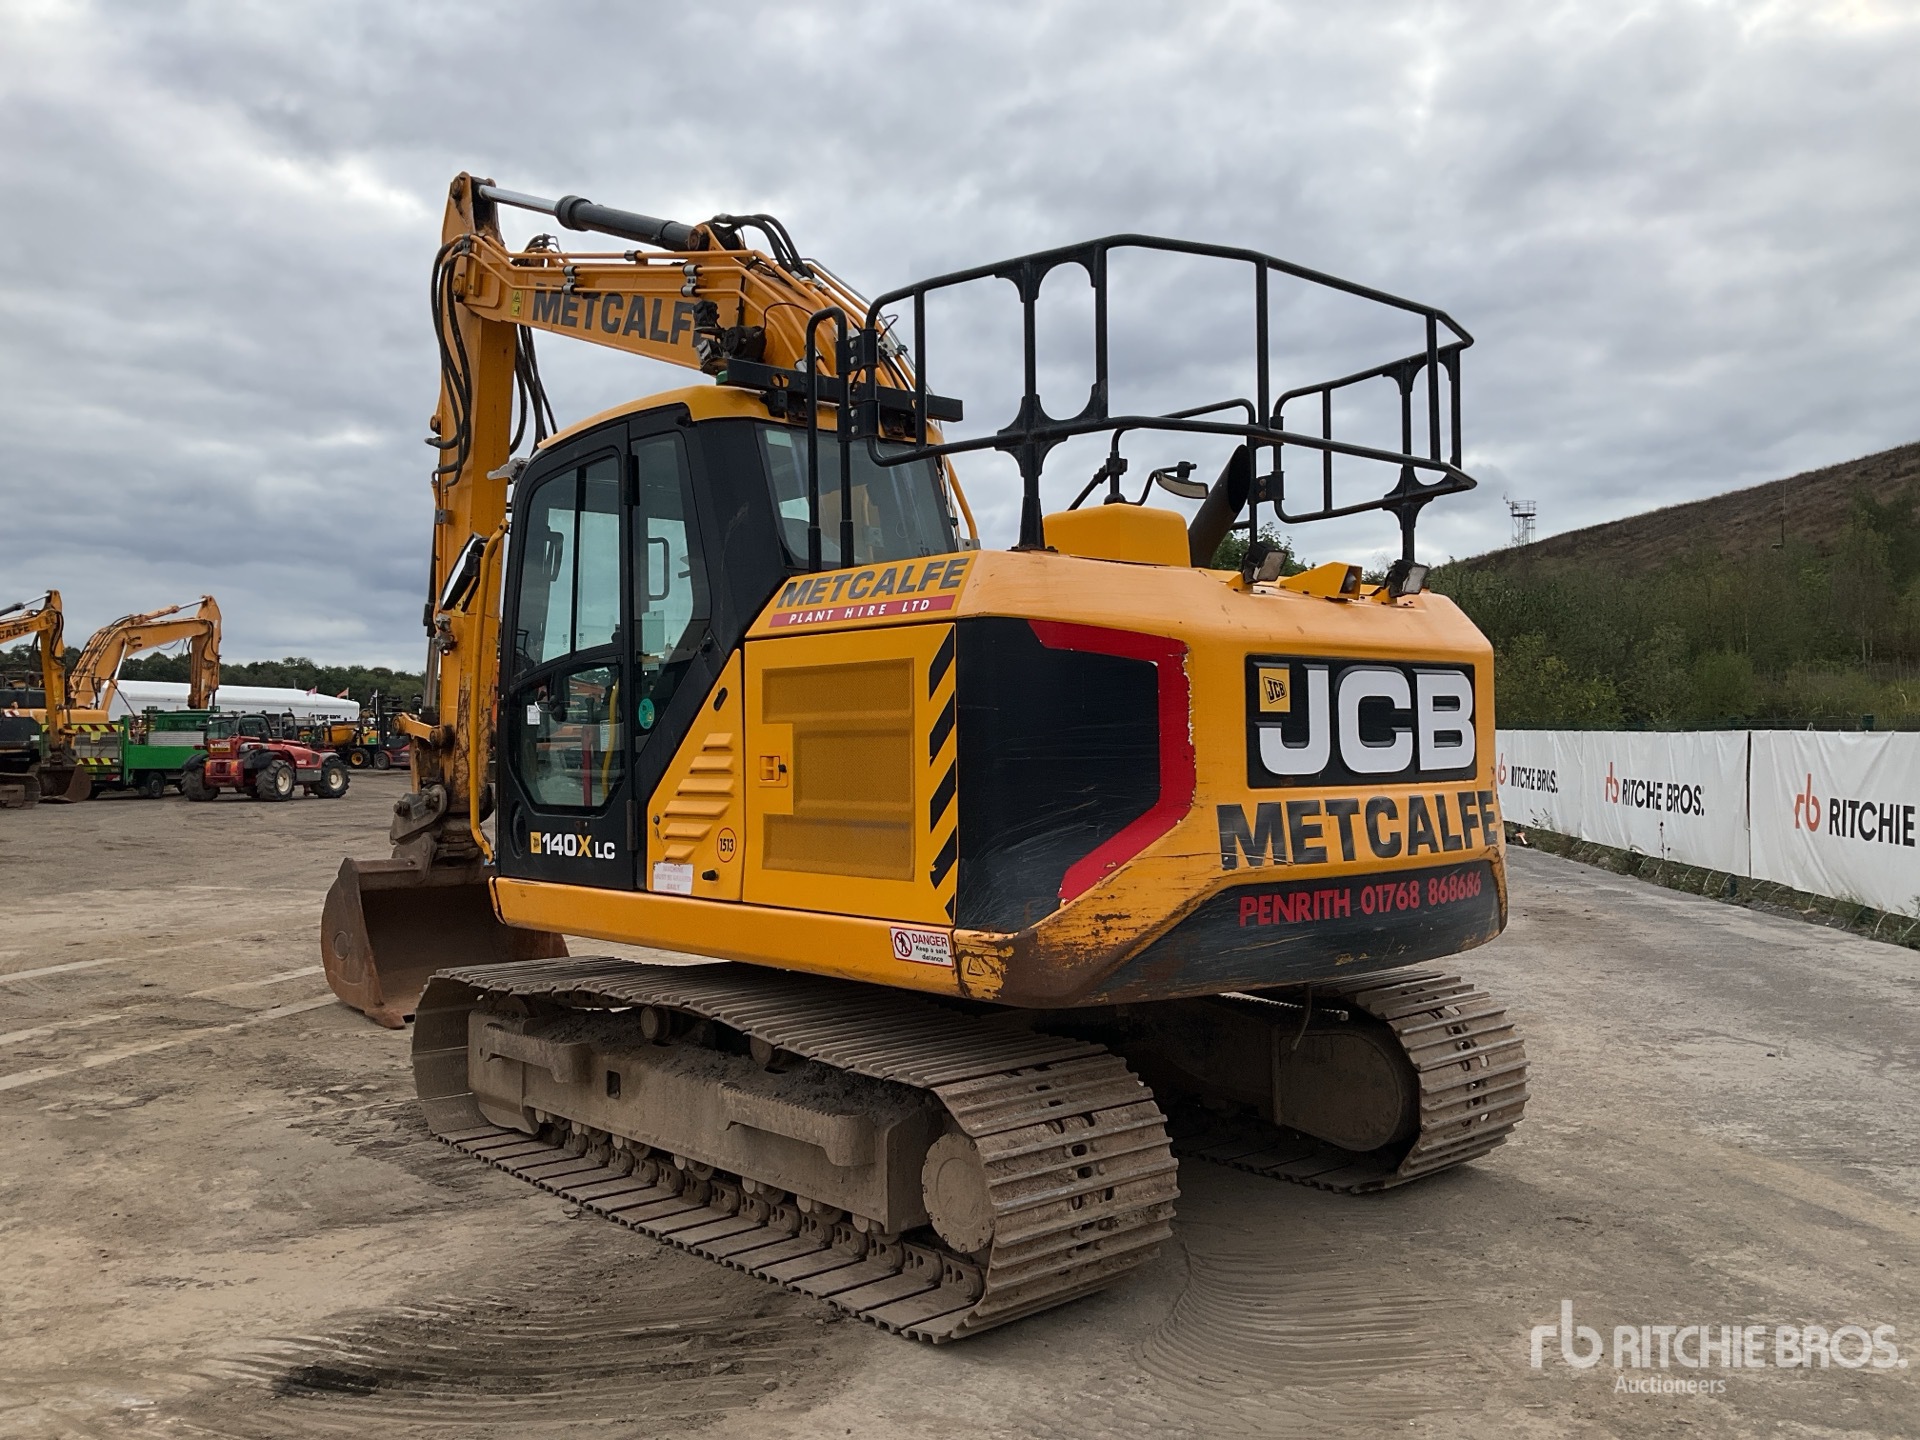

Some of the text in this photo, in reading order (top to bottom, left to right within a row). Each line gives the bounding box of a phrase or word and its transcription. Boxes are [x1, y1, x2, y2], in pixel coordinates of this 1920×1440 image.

[776, 557, 970, 609] METCALFE
[788, 599, 931, 625] PLANT HIRE LTD
[1266, 678, 1287, 700] JCB
[1258, 665, 1476, 776] JCB
[1511, 765, 1535, 791] ITCHE
[1622, 778, 1663, 811] RITCHE
[1666, 783, 1705, 816] BROS.
[1216, 790, 1499, 870] METCALFE
[1828, 797, 1915, 847] RITCHIE
[594, 841, 616, 860] LC
[719, 838, 734, 853] 1513
[1239, 870, 1483, 928] PENRITH 01768 868686
[911, 933, 948, 948] DANGER
[915, 945, 930, 954] Keep
[921, 954, 944, 963] distance
